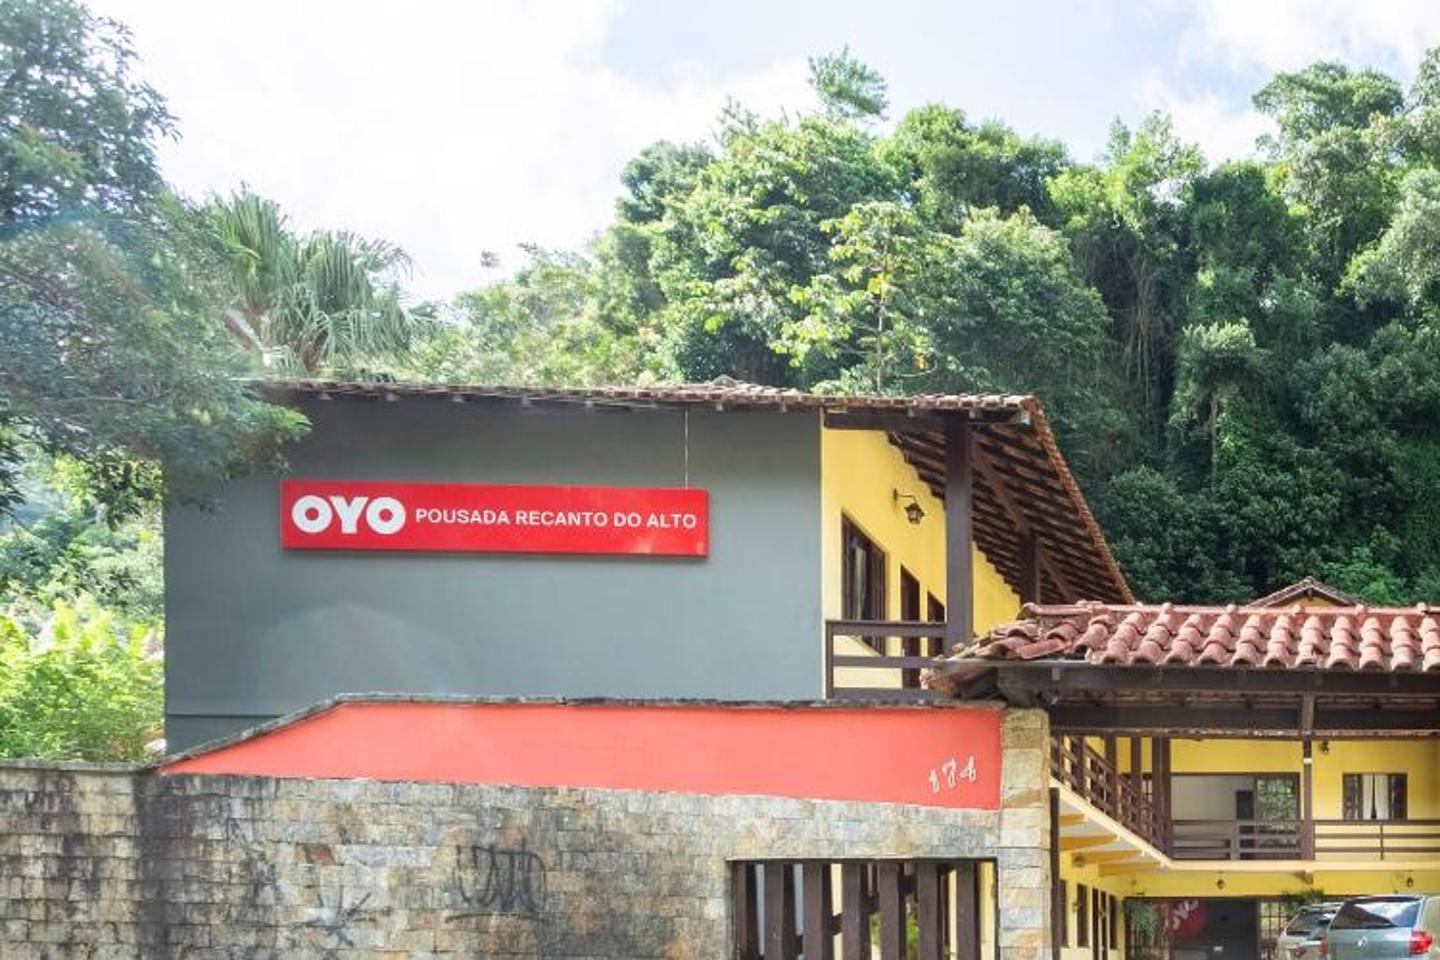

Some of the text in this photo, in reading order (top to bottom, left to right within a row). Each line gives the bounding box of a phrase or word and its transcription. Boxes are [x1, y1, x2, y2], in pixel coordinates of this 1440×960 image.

[291, 494, 697, 535] OYO POUSADA RECANTO DO ALTO
